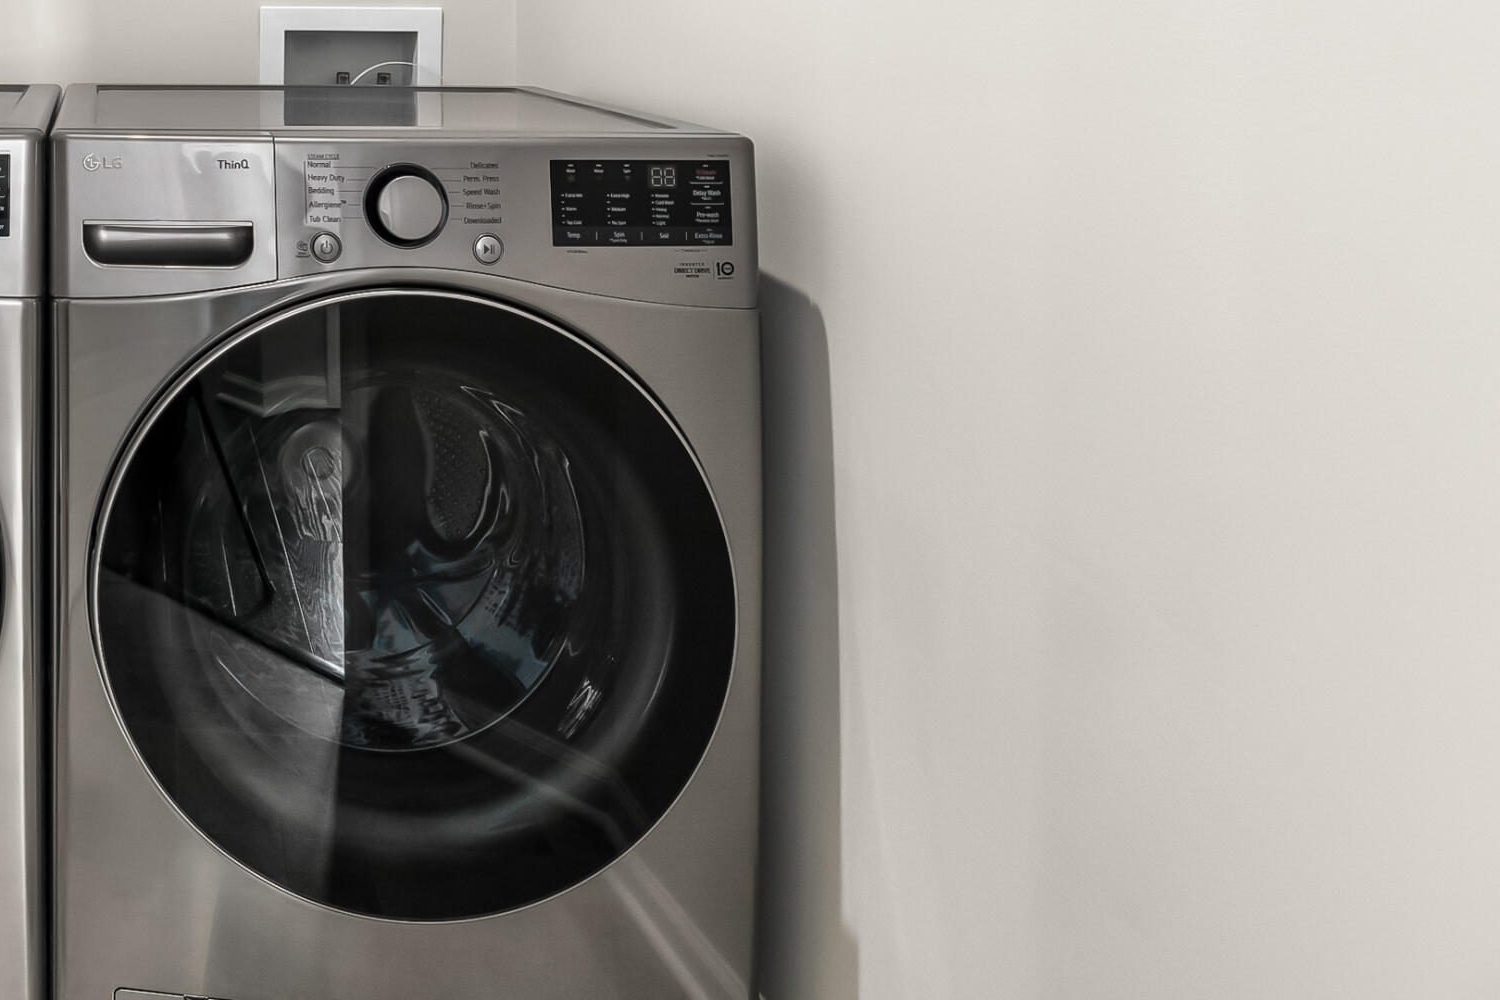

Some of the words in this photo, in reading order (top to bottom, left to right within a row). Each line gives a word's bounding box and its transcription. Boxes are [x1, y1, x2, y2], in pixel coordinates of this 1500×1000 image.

[217, 159, 250, 170] ThinQ
[307, 174, 327, 182] Heavy
[329, 174, 345, 182] Duty
[308, 187, 334, 195] Bedding
[462, 188, 482, 196] Speed
